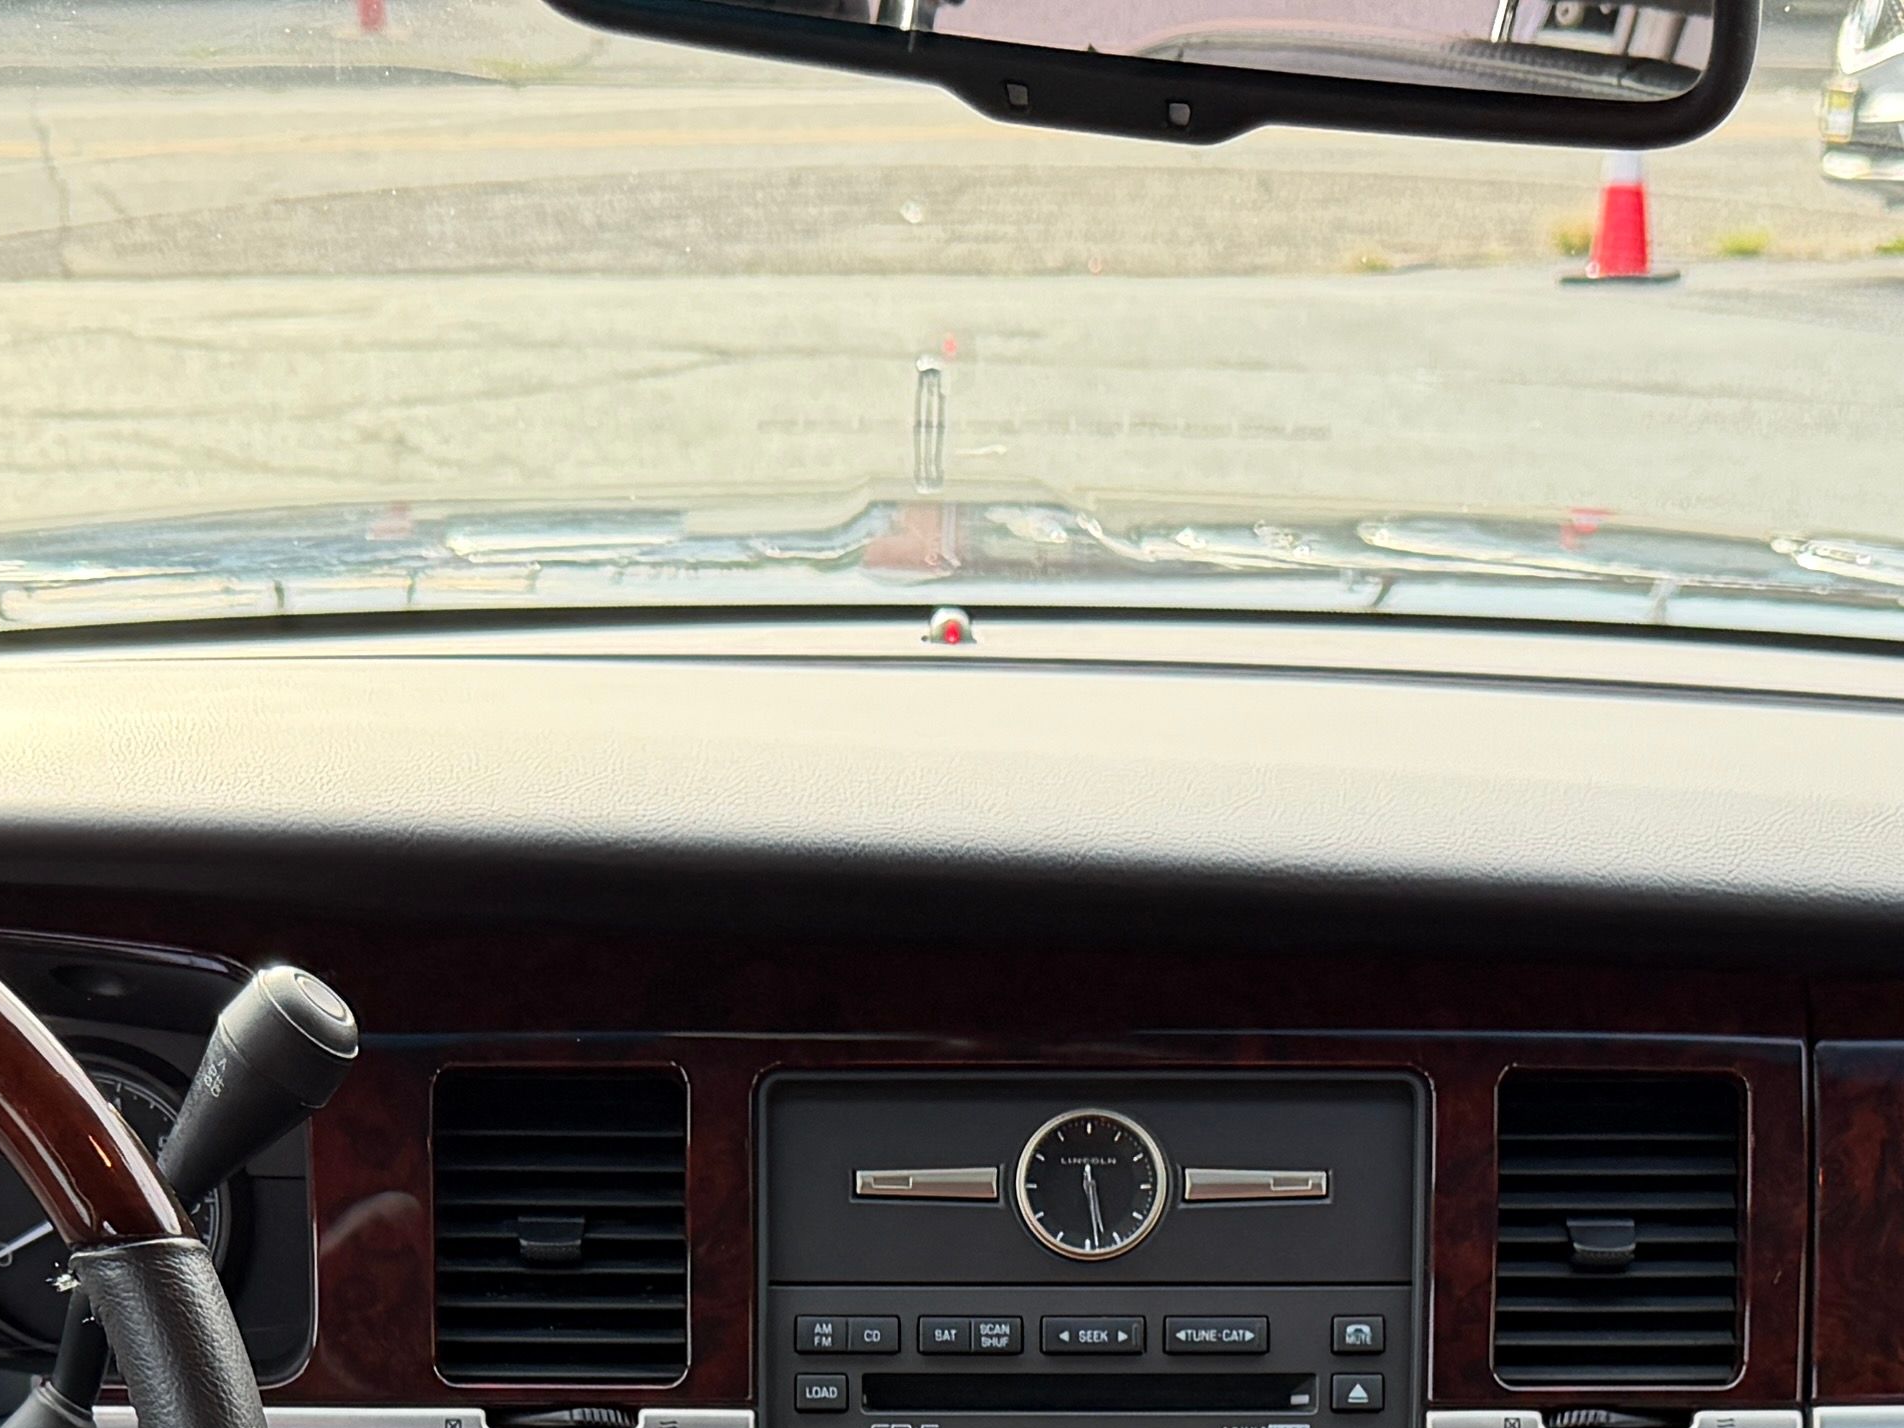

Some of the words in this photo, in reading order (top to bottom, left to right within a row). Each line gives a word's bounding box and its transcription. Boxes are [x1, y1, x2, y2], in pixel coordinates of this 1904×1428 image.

[1060, 1157, 1117, 1165] LINCOLN
[814, 1323, 832, 1335] AM
[934, 1329, 957, 1341] SAT
[980, 1323, 1010, 1335] SCAN
[814, 1336, 832, 1347] FM
[863, 1330, 881, 1342] CD
[980, 1336, 1010, 1348] SHUF
[1078, 1330, 1109, 1343] SEEK
[1345, 1334, 1372, 1345] MUTE
[805, 1386, 838, 1399] LOAD
